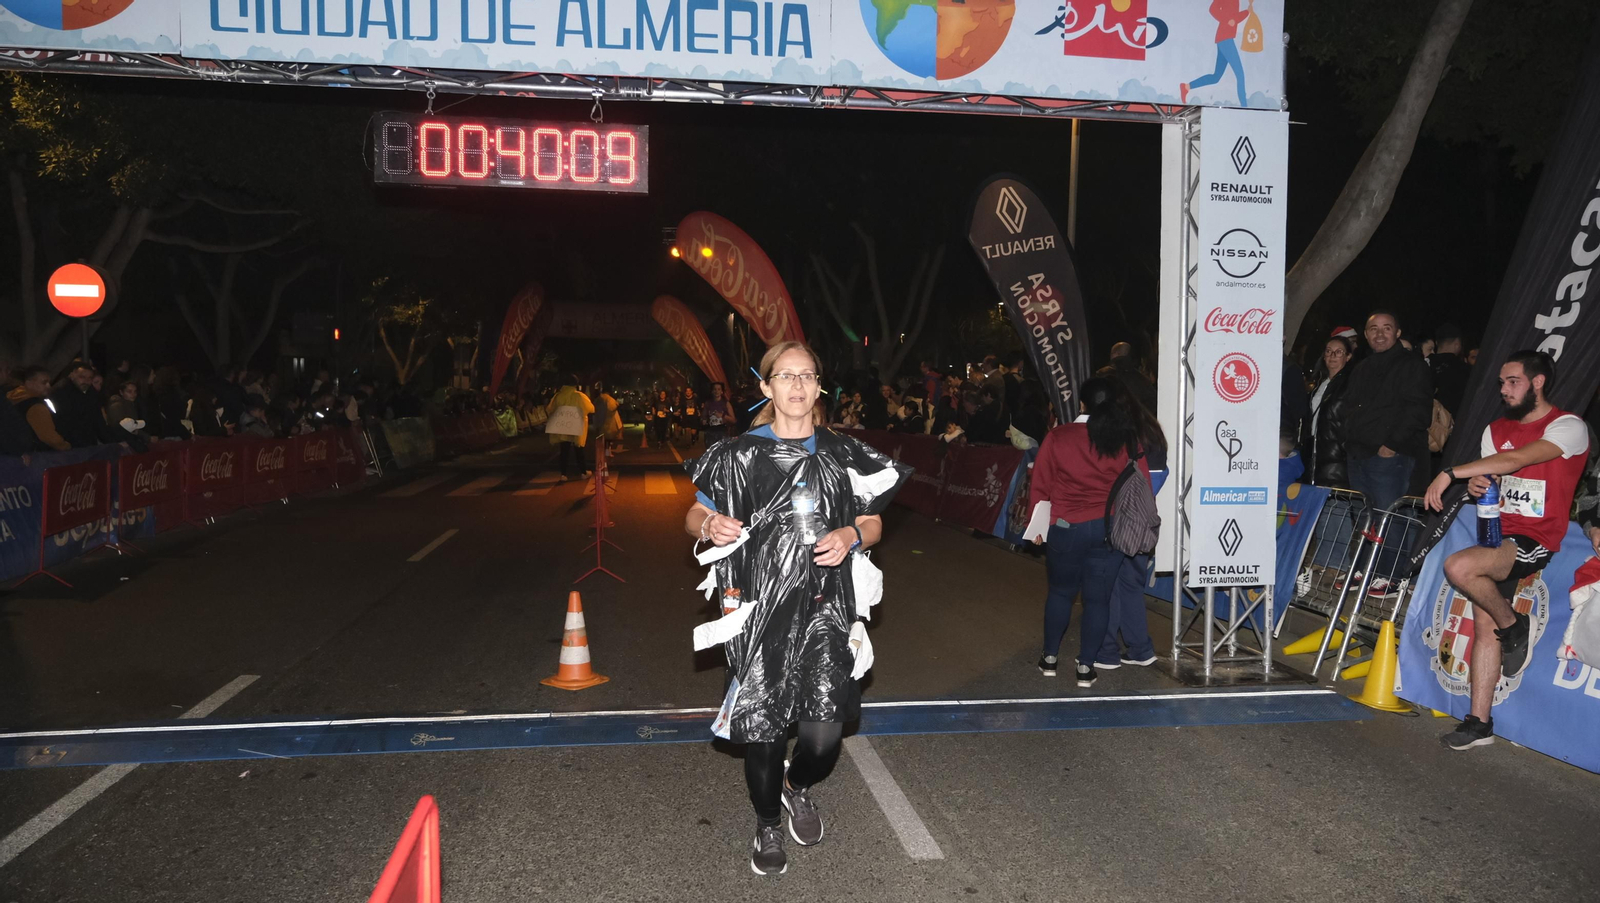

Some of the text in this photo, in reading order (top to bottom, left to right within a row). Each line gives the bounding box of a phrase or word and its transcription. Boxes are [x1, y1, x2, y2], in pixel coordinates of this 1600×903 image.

[210, 0, 812, 58] CIUDAD DE ALMERIA
[419, 121, 635, 185] 00:40:09
[1210, 182, 1274, 195] RENAULT
[1210, 194, 1230, 202] SYRSA
[1210, 248, 1269, 259] NISSAN
[1215, 281, 1267, 289] andalmotor.es
[502, 287, 542, 358] Coca-Cola
[1204, 306, 1277, 335] Coca-Cola
[1228, 438, 1259, 475] Paquita
[200, 451, 234, 482] Coca-Cola
[132, 458, 170, 497] Coca-Cola
[59, 472, 99, 516] Coca-Cola
[1202, 490, 1247, 502] Almericar
[1505, 488, 1531, 503] 444
[1198, 564, 1260, 575] RENAULT
[1198, 576, 1218, 584] SYRSA
[1442, 679, 1470, 693] CIUDAD DE
